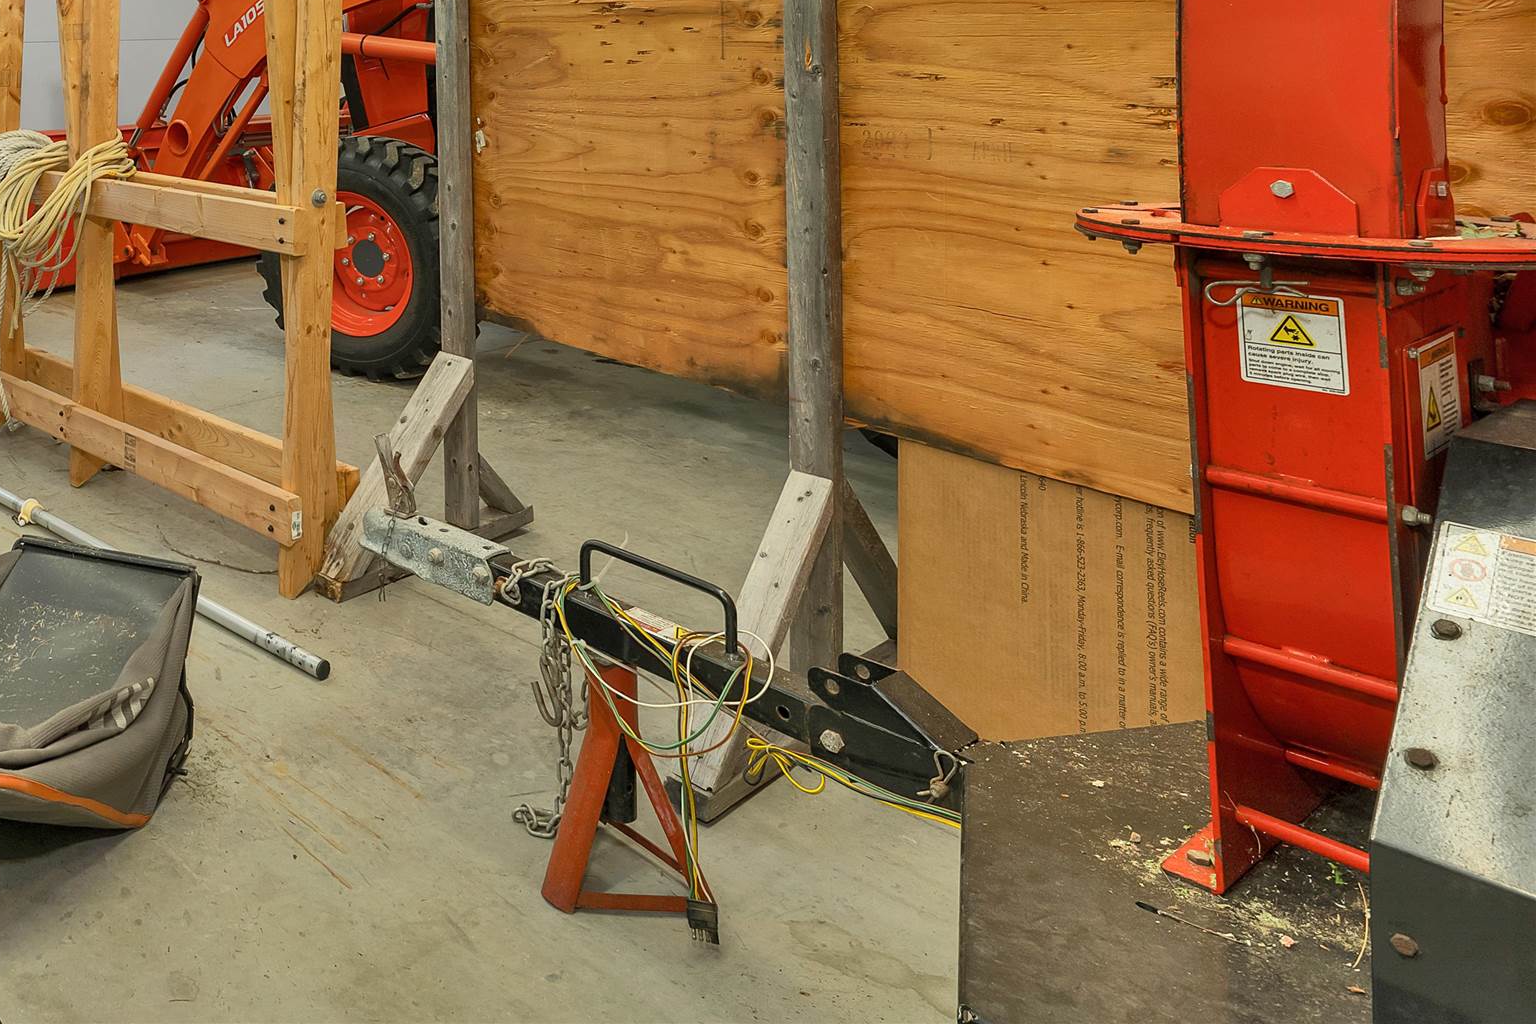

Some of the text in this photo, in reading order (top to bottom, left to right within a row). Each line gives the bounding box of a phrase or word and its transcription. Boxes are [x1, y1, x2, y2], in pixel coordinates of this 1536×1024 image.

[1262, 296, 1330, 312] WARNING
[1247, 345, 1274, 353] Rotating
[1075, 496, 1085, 522] hotline
[1144, 517, 1156, 556] frequently
[1156, 520, 1167, 529] of
[1019, 474, 1030, 604] Lincoln Nebraska and Made in China.
[1075, 532, 1086, 593] 1-866-523-2363,
[1116, 544, 1125, 569] E-mail
[1147, 558, 1156, 581] asked
[1155, 530, 1168, 625] www.EleyHoseReels.com
[1115, 570, 1126, 631] correspondence
[1146, 582, 1156, 619] questions
[1075, 594, 1087, 651] Monday-Friday,
[1146, 620, 1158, 650] (FAQ's)
[1116, 639, 1127, 667] replied
[1158, 626, 1168, 659] contains
[1078, 653, 1087, 672] 8:00
[1118, 668, 1126, 677] to
[1148, 651, 1157, 682] owner's
[1078, 672, 1086, 688] a.m.
[1159, 668, 1169, 687] wide
[1078, 691, 1087, 699] to
[1118, 694, 1127, 720] matter
[1148, 682, 1159, 717] manuals,
[1157, 688, 1167, 711] range
[1078, 701, 1088, 719] 5:00
[1159, 713, 1170, 724] of
